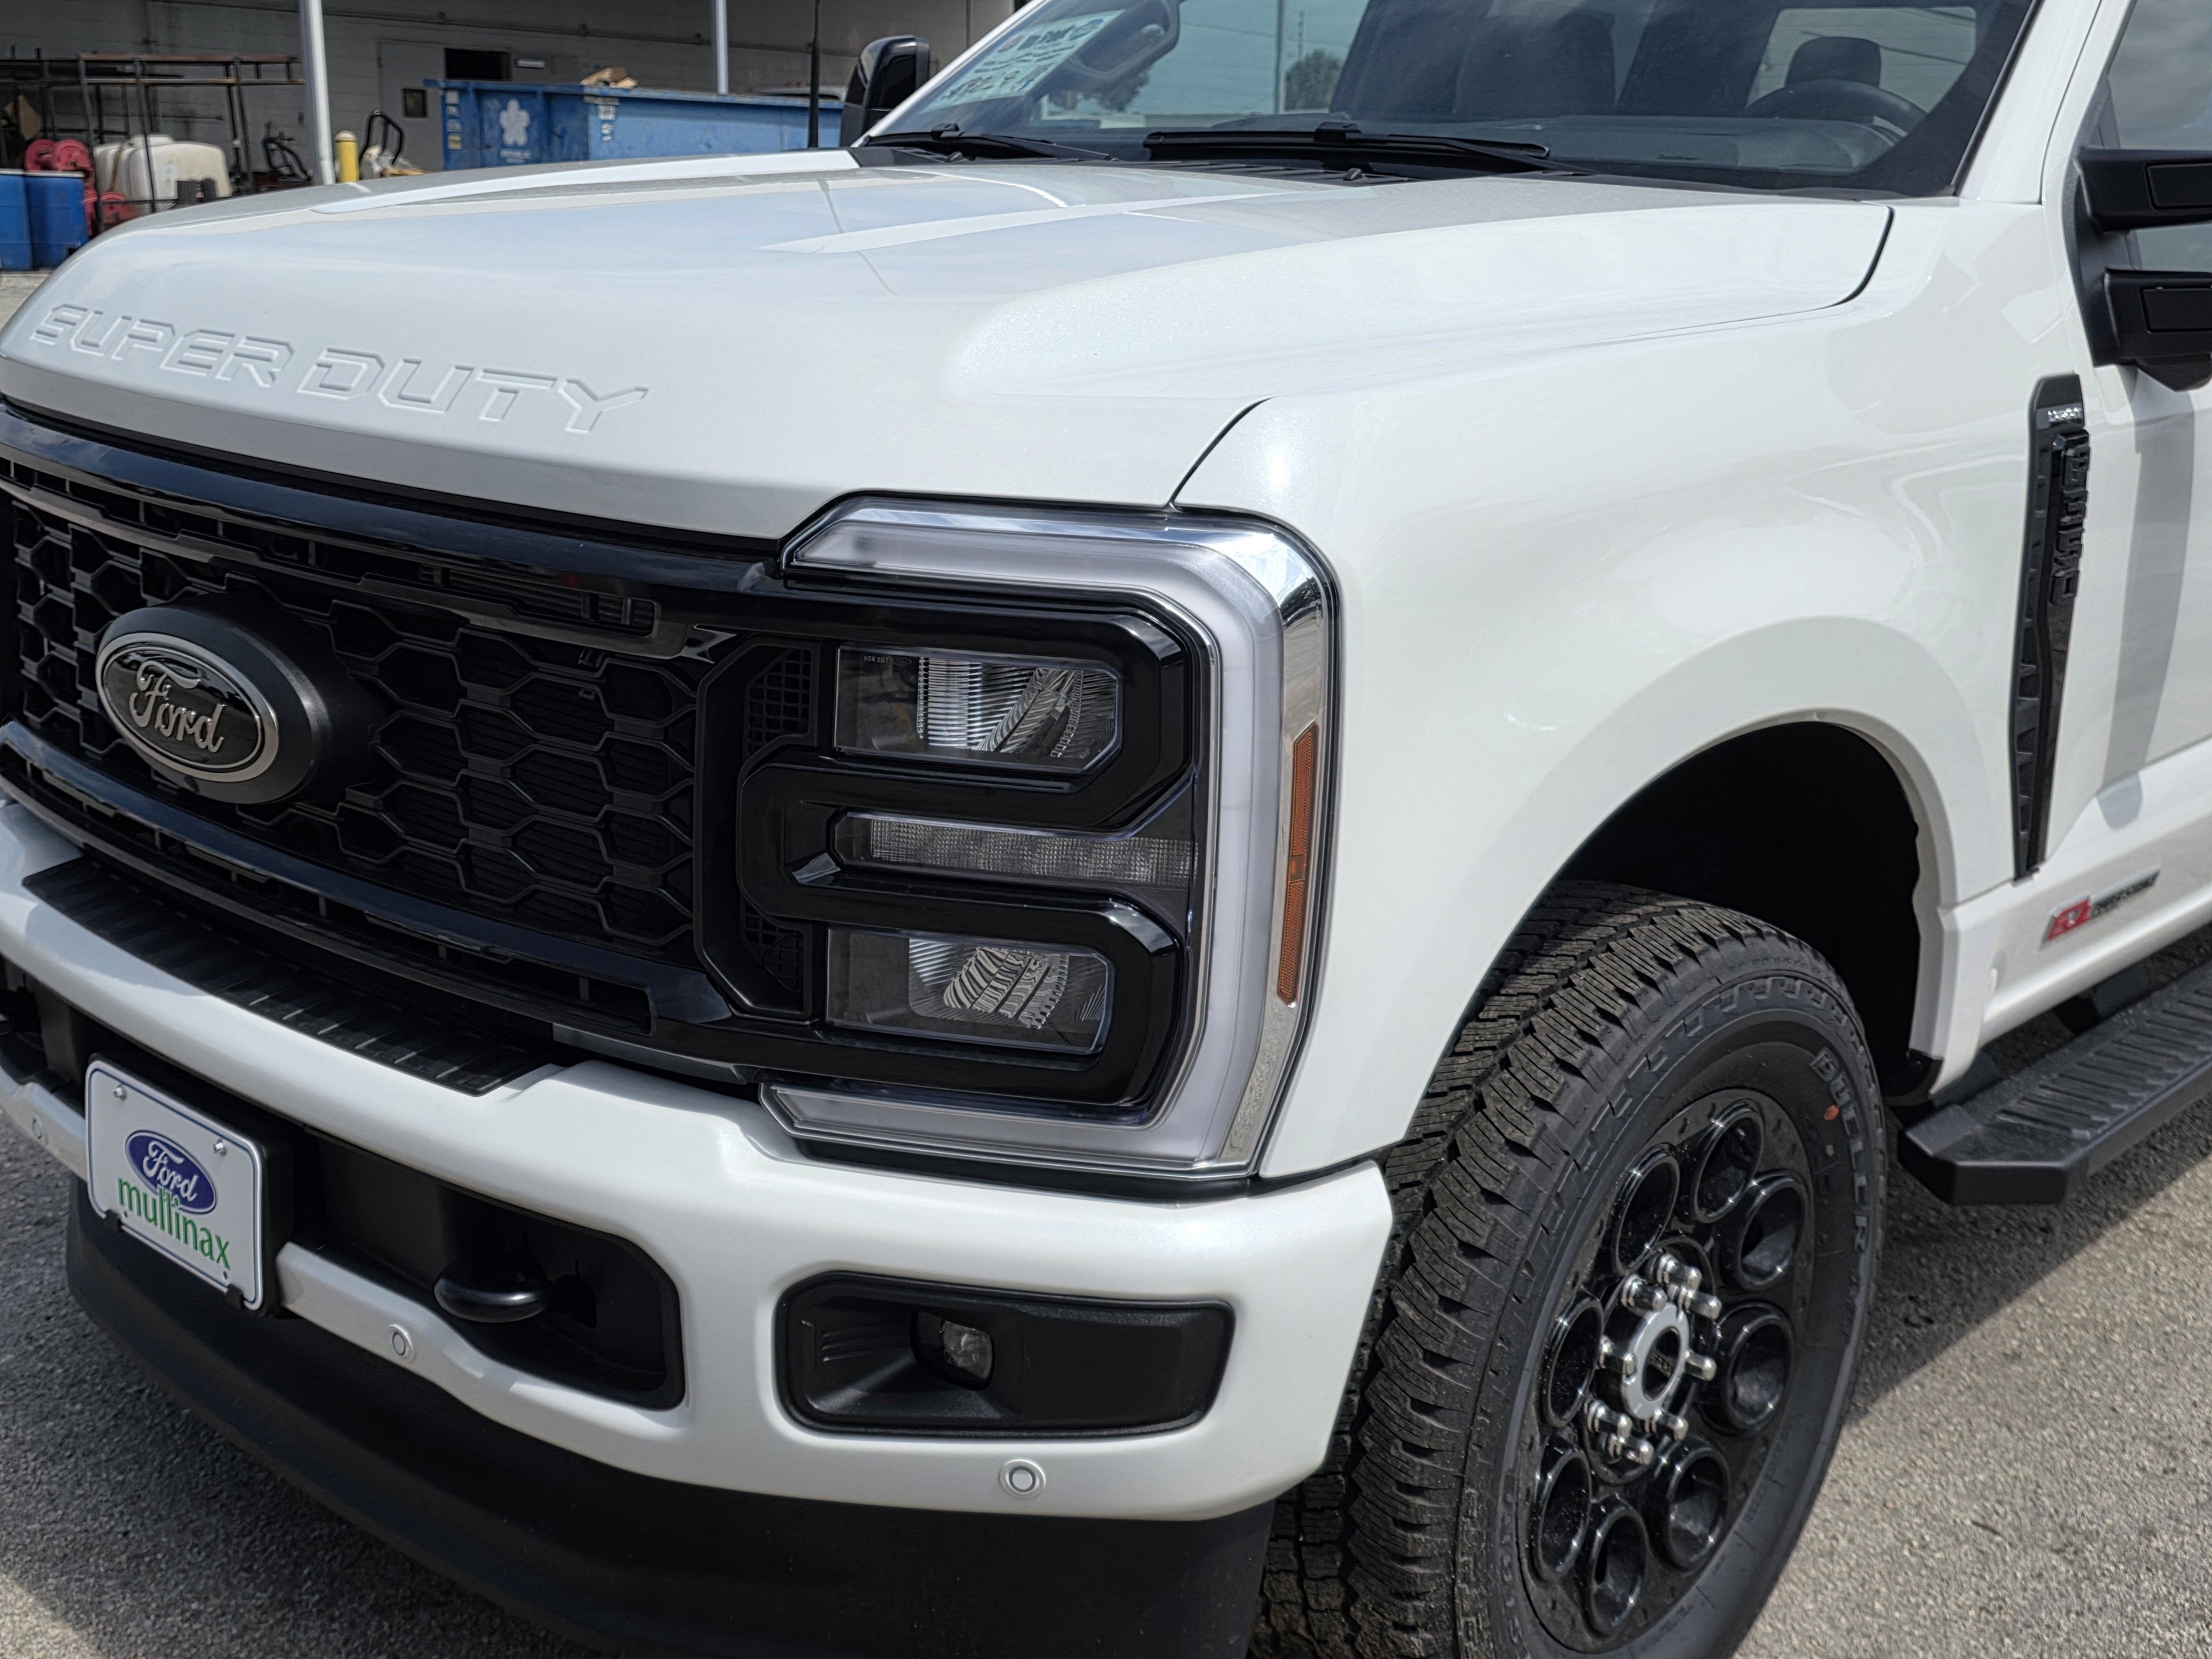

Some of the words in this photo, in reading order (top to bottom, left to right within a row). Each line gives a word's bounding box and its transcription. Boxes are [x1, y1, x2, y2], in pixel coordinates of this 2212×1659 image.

[29, 303, 295, 389] SUPER
[296, 346, 649, 435] DUTY
[128, 659, 227, 754] Ford
[143, 1141, 197, 1201] Ford
[1809, 1046, 1869, 1251] DUELER
[117, 1177, 231, 1271] mullinax
